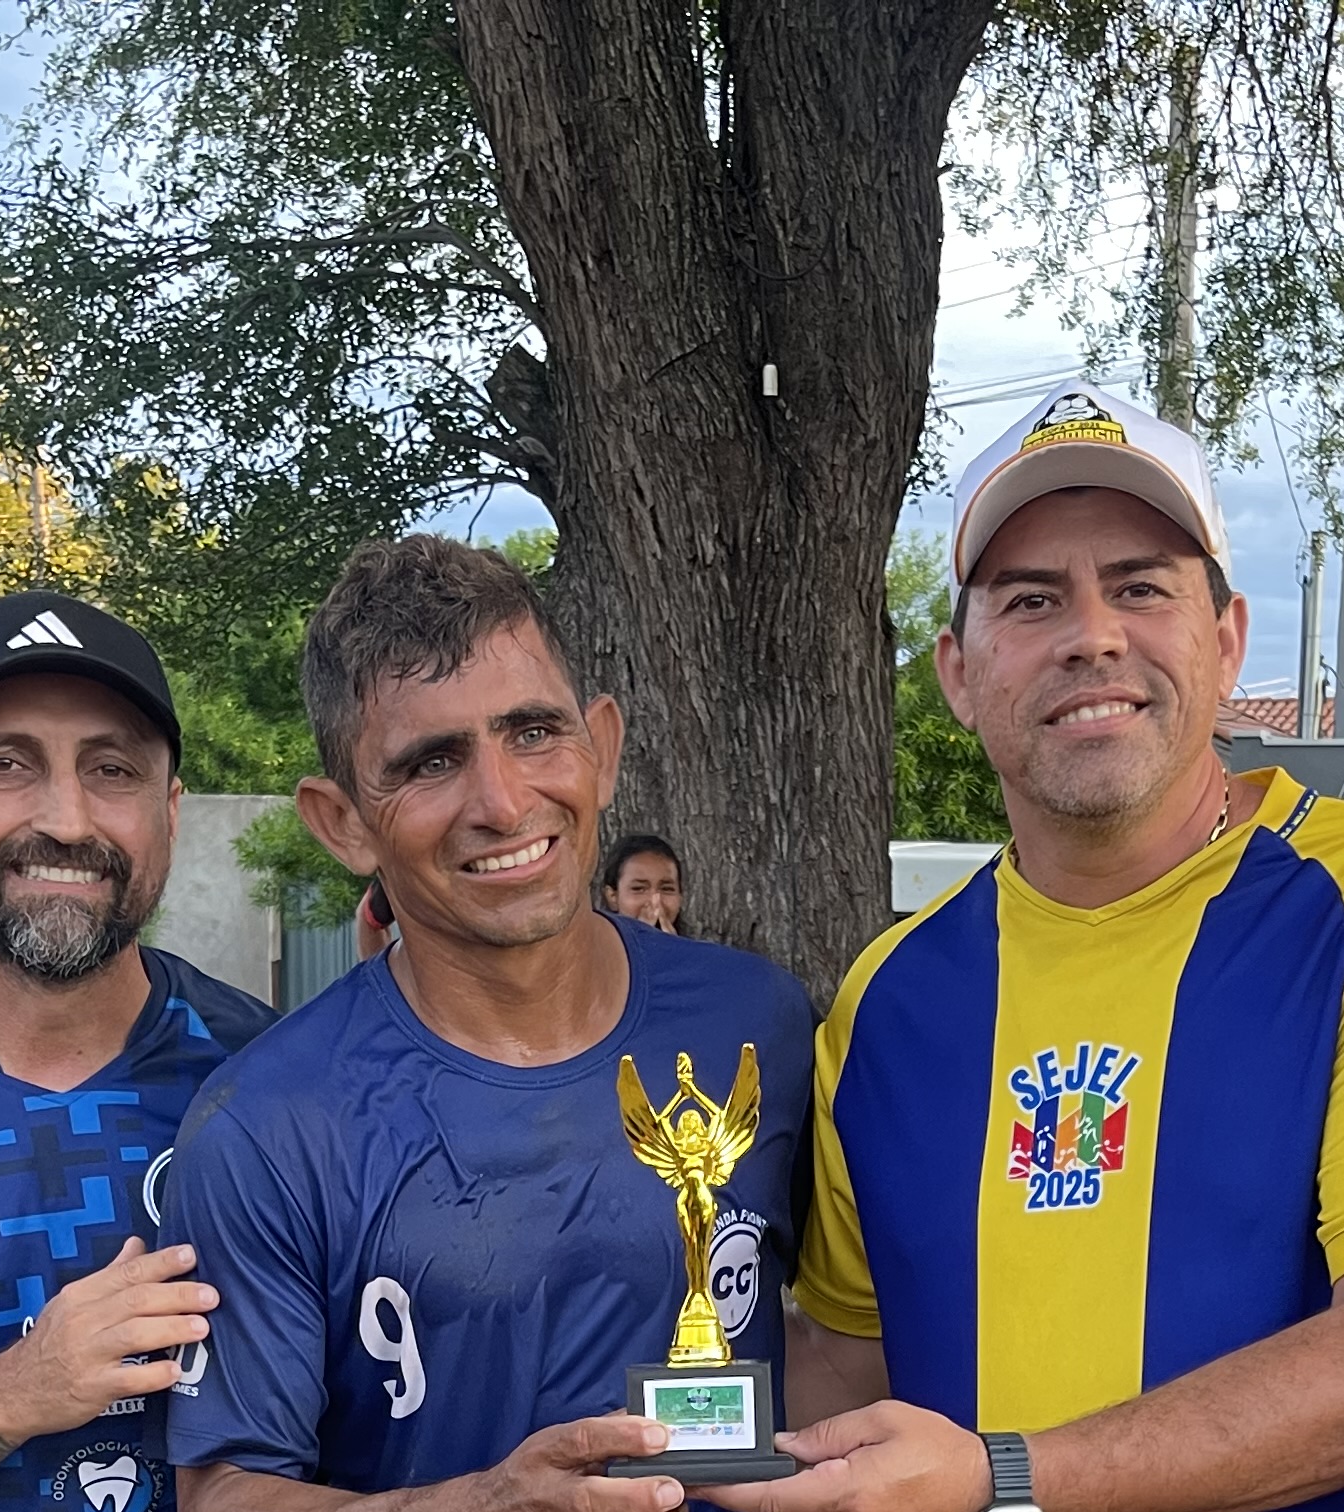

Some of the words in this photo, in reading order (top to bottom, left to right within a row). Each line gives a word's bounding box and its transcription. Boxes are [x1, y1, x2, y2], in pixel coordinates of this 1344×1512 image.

[1011, 1045, 1139, 1110] SEJEL
[1027, 1167, 1102, 1209] 2025
[711, 1262, 754, 1301] CC
[358, 1276, 427, 1420] 9
[53, 1440, 131, 1502] ODONTOLOGIA
